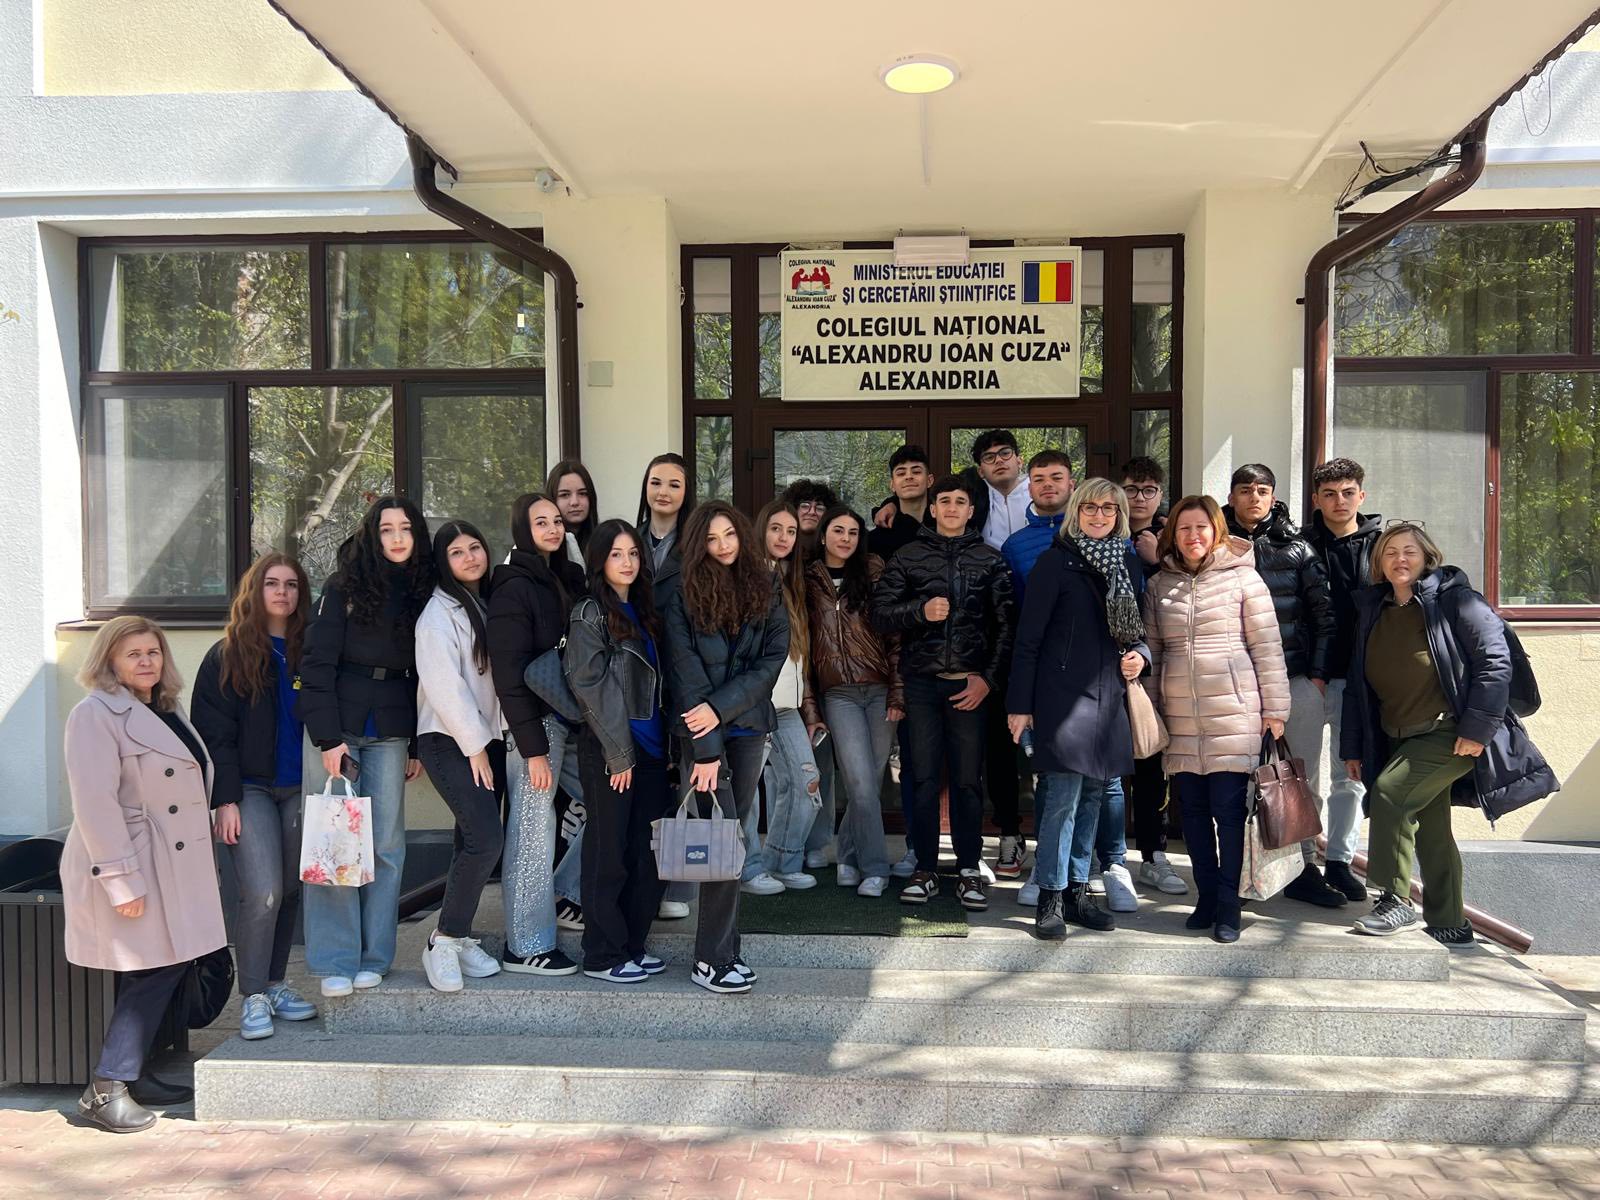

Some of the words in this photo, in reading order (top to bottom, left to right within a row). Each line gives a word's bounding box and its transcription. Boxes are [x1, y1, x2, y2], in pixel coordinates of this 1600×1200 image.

[853, 264, 932, 281] MINISTERUL
[936, 262, 1005, 280] EDUCAȚIEI
[842, 286, 855, 305] ȘI
[858, 282, 935, 303] CERCETĂRII
[939, 284, 1016, 304] ȘTIINȚIFICE
[816, 316, 926, 337] COLEGIUL
[933, 315, 1045, 340] NAȚIONAL
[859, 370, 1000, 391] ALEXANDRIA
